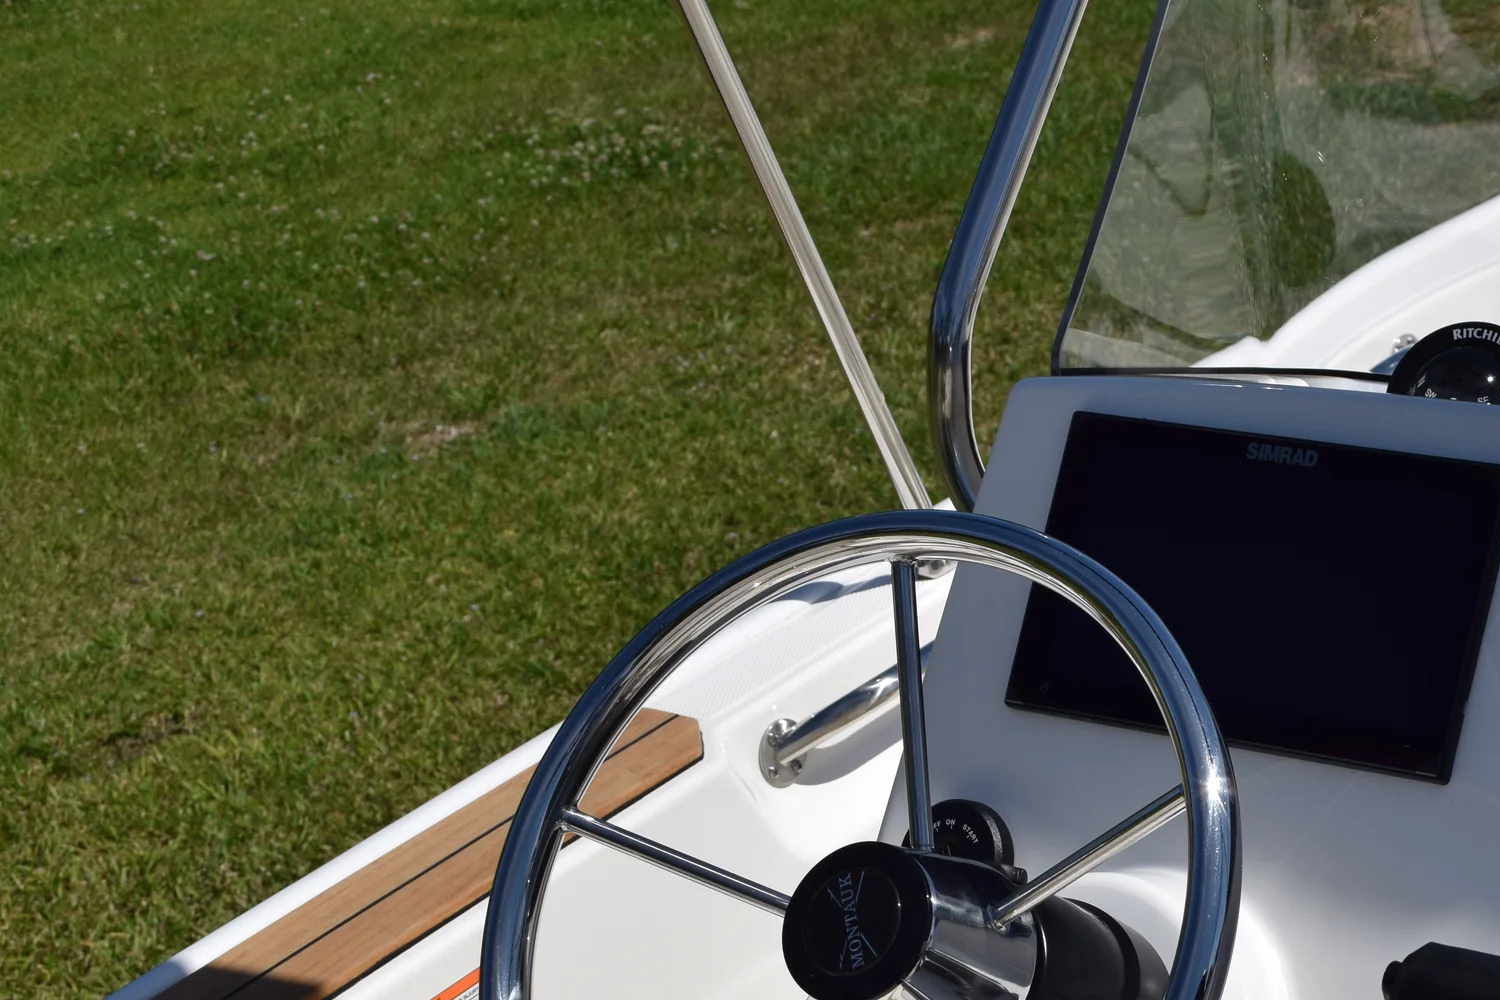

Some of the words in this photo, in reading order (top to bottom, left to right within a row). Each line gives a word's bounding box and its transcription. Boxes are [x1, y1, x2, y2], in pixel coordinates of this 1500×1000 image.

[1245, 442, 1319, 467] SIMRAD
[945, 818, 956, 826] ON
[962, 823, 980, 844] START
[838, 871, 866, 970] MONTAUK
